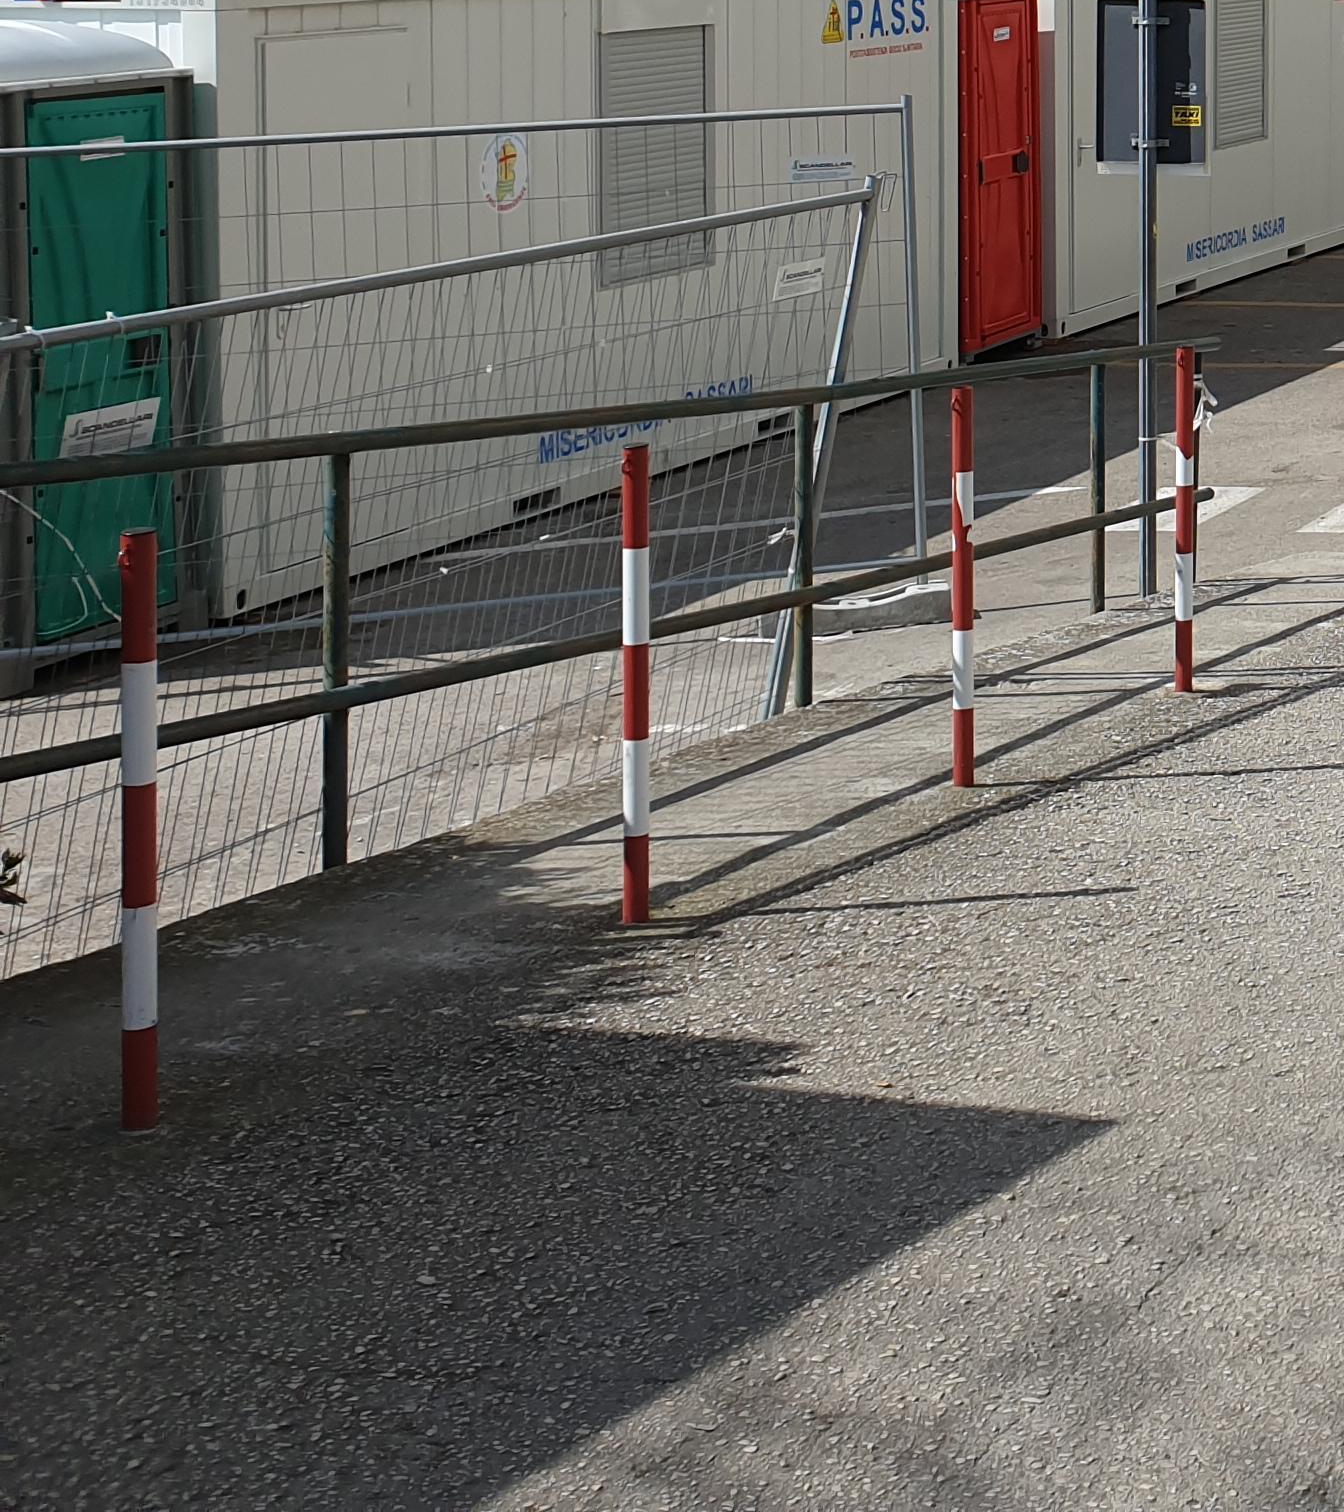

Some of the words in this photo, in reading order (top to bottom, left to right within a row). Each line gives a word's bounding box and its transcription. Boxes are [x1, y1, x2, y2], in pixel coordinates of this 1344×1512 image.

[1173, 110, 1200, 119] TAXI
[1186, 226, 1247, 263] MISERICORDIA
[1252, 215, 1286, 243] SASSARI
